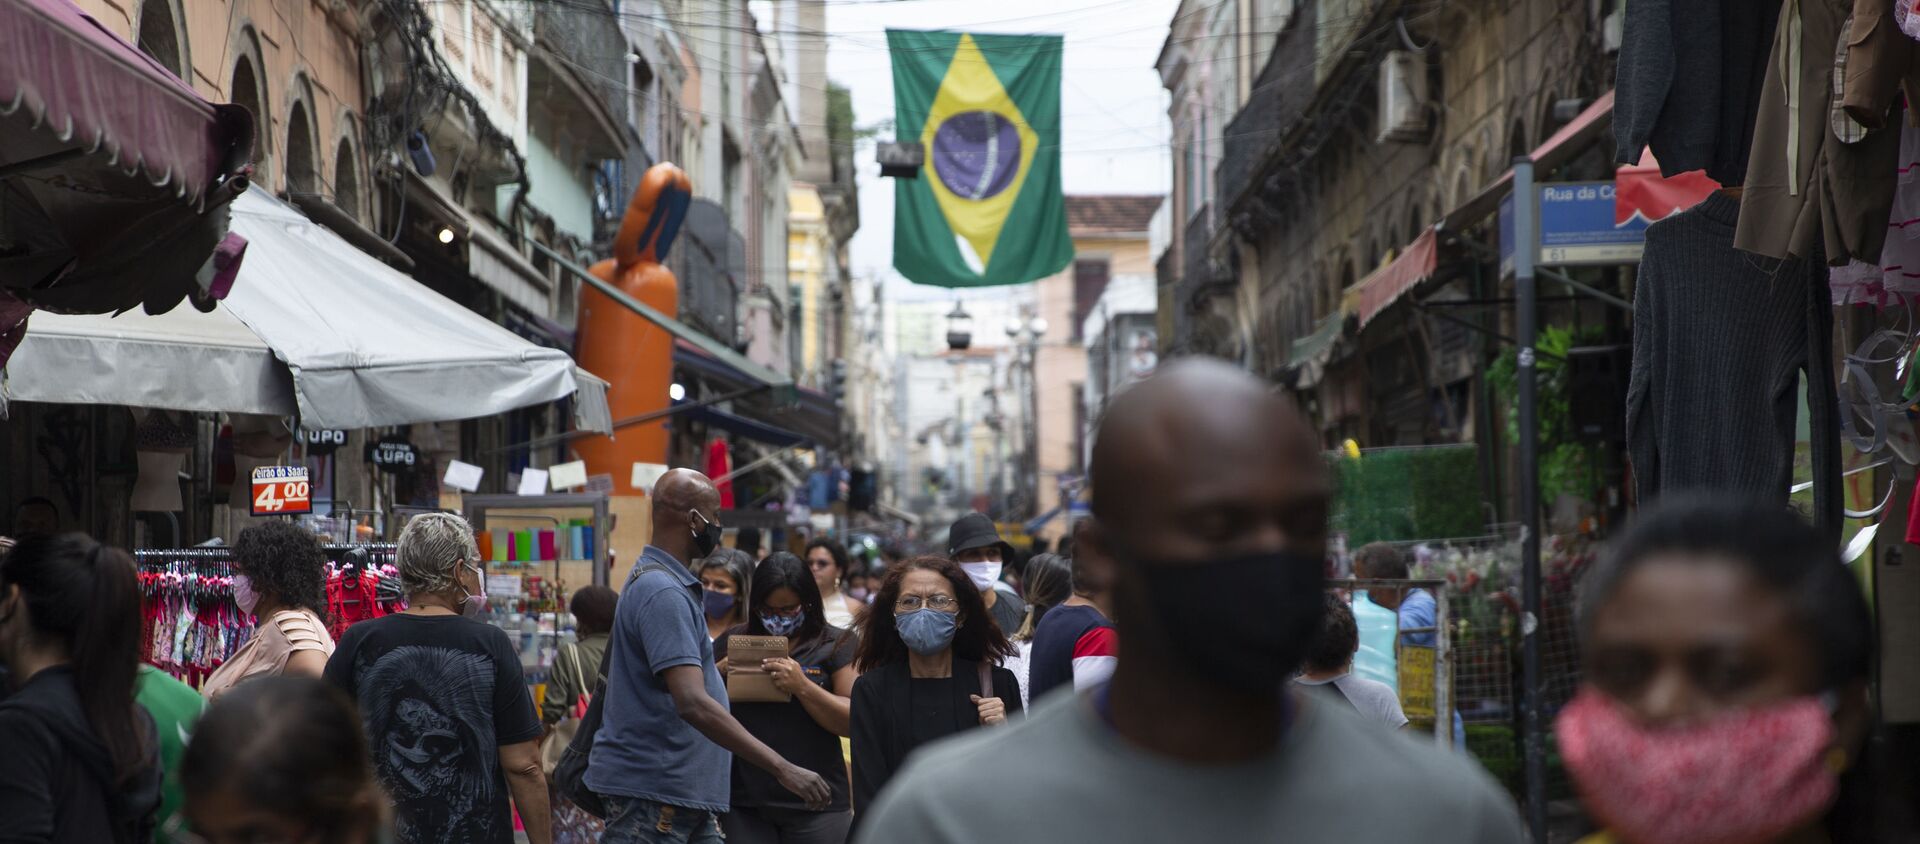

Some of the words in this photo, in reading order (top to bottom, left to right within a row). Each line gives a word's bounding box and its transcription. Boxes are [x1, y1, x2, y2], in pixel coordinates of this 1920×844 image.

[1544, 187, 1574, 201] Rua
[1577, 186, 1597, 200] da
[374, 448, 415, 465] LUPO
[276, 466, 286, 477] do
[287, 466, 309, 477] Saara
[254, 481, 309, 511] 4,00
